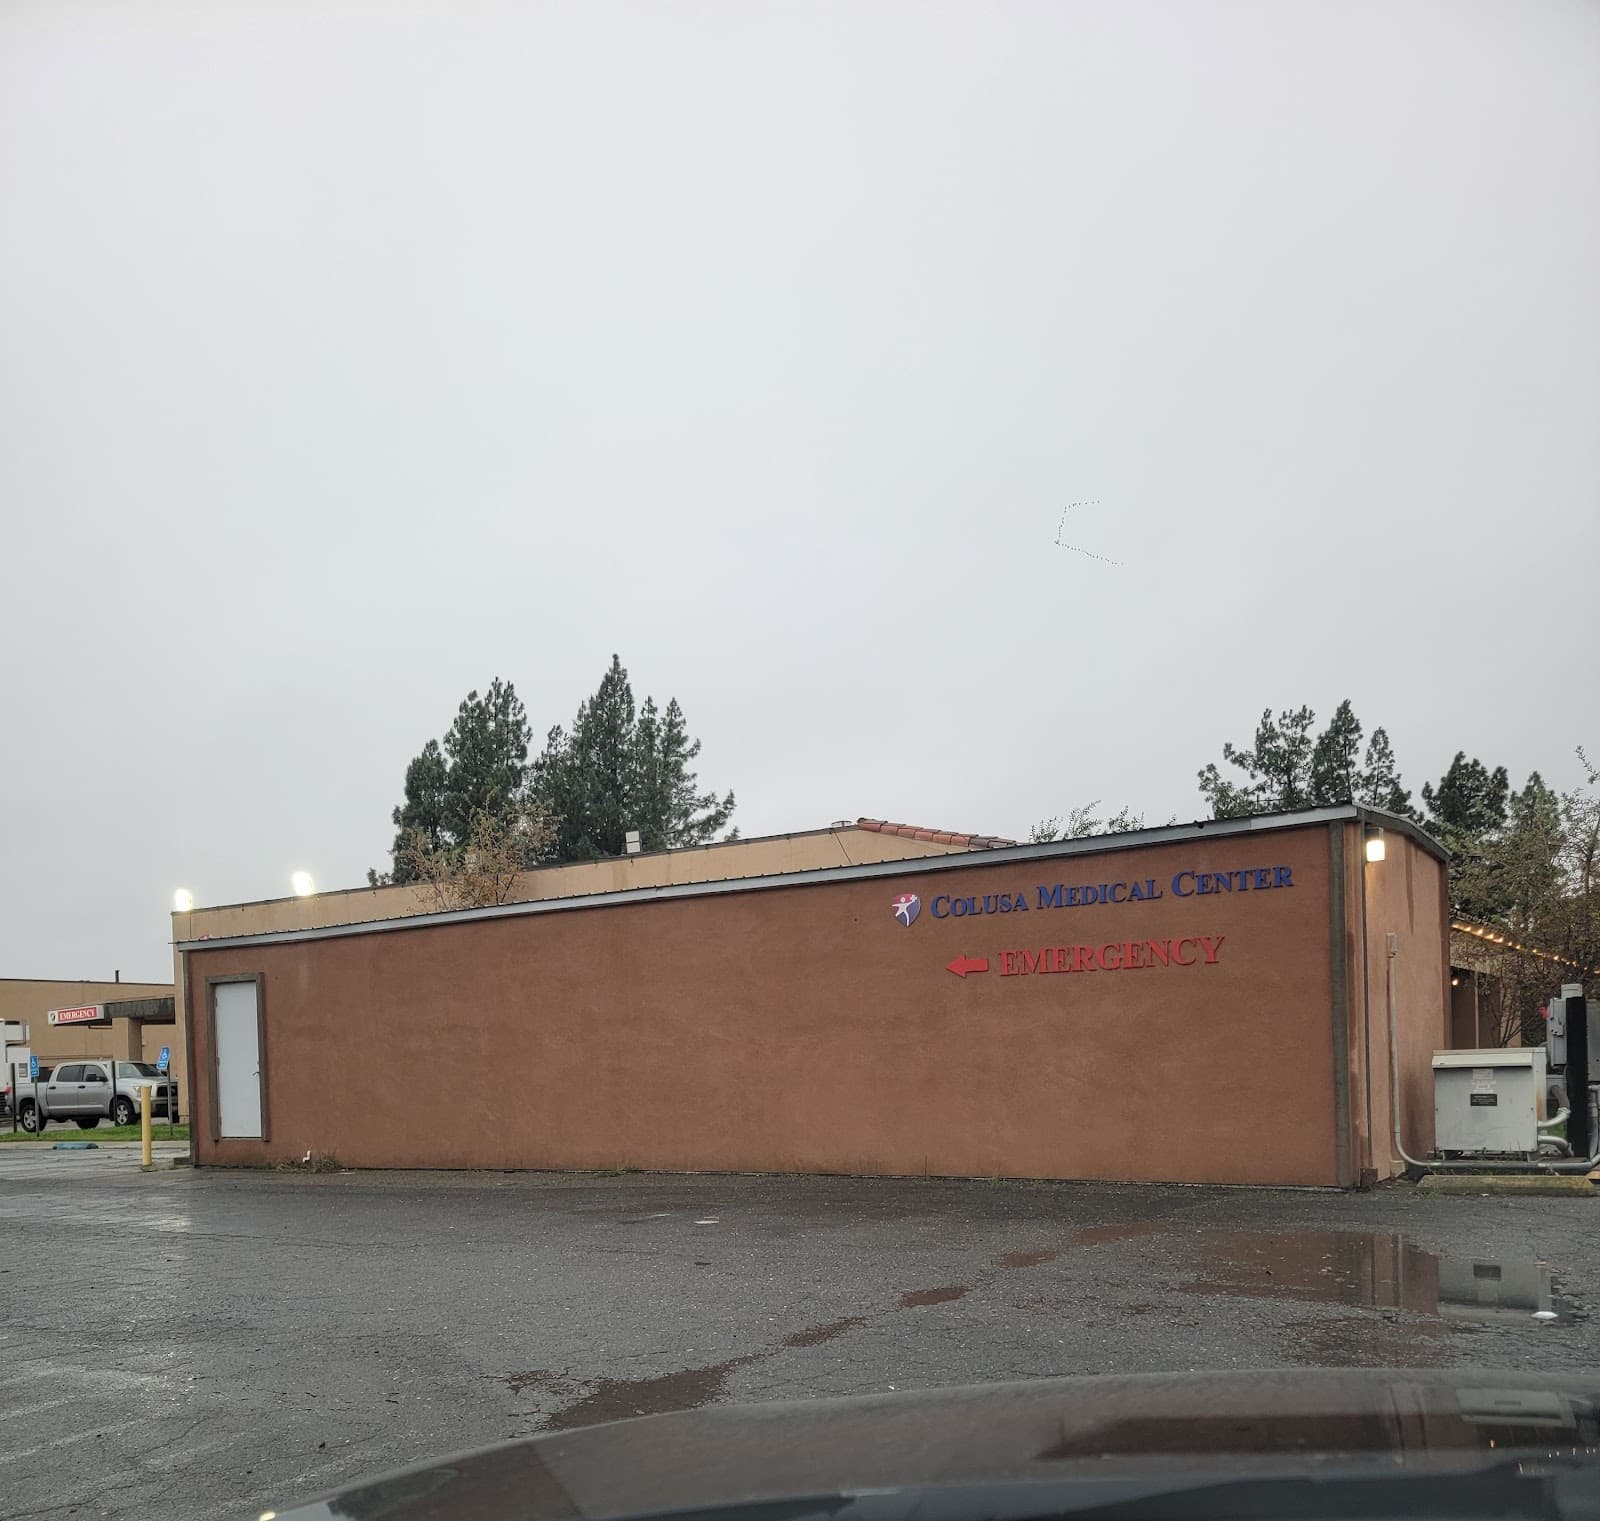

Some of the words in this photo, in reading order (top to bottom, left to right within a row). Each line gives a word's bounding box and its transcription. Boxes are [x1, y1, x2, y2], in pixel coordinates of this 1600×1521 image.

[930, 893, 1028, 919] COLUSA
[1036, 880, 1162, 910] MEDICAL
[1171, 866, 1294, 897] CENTER
[998, 936, 1225, 976] EMERGENCY
[59, 1008, 96, 1021] EMERGENCY
